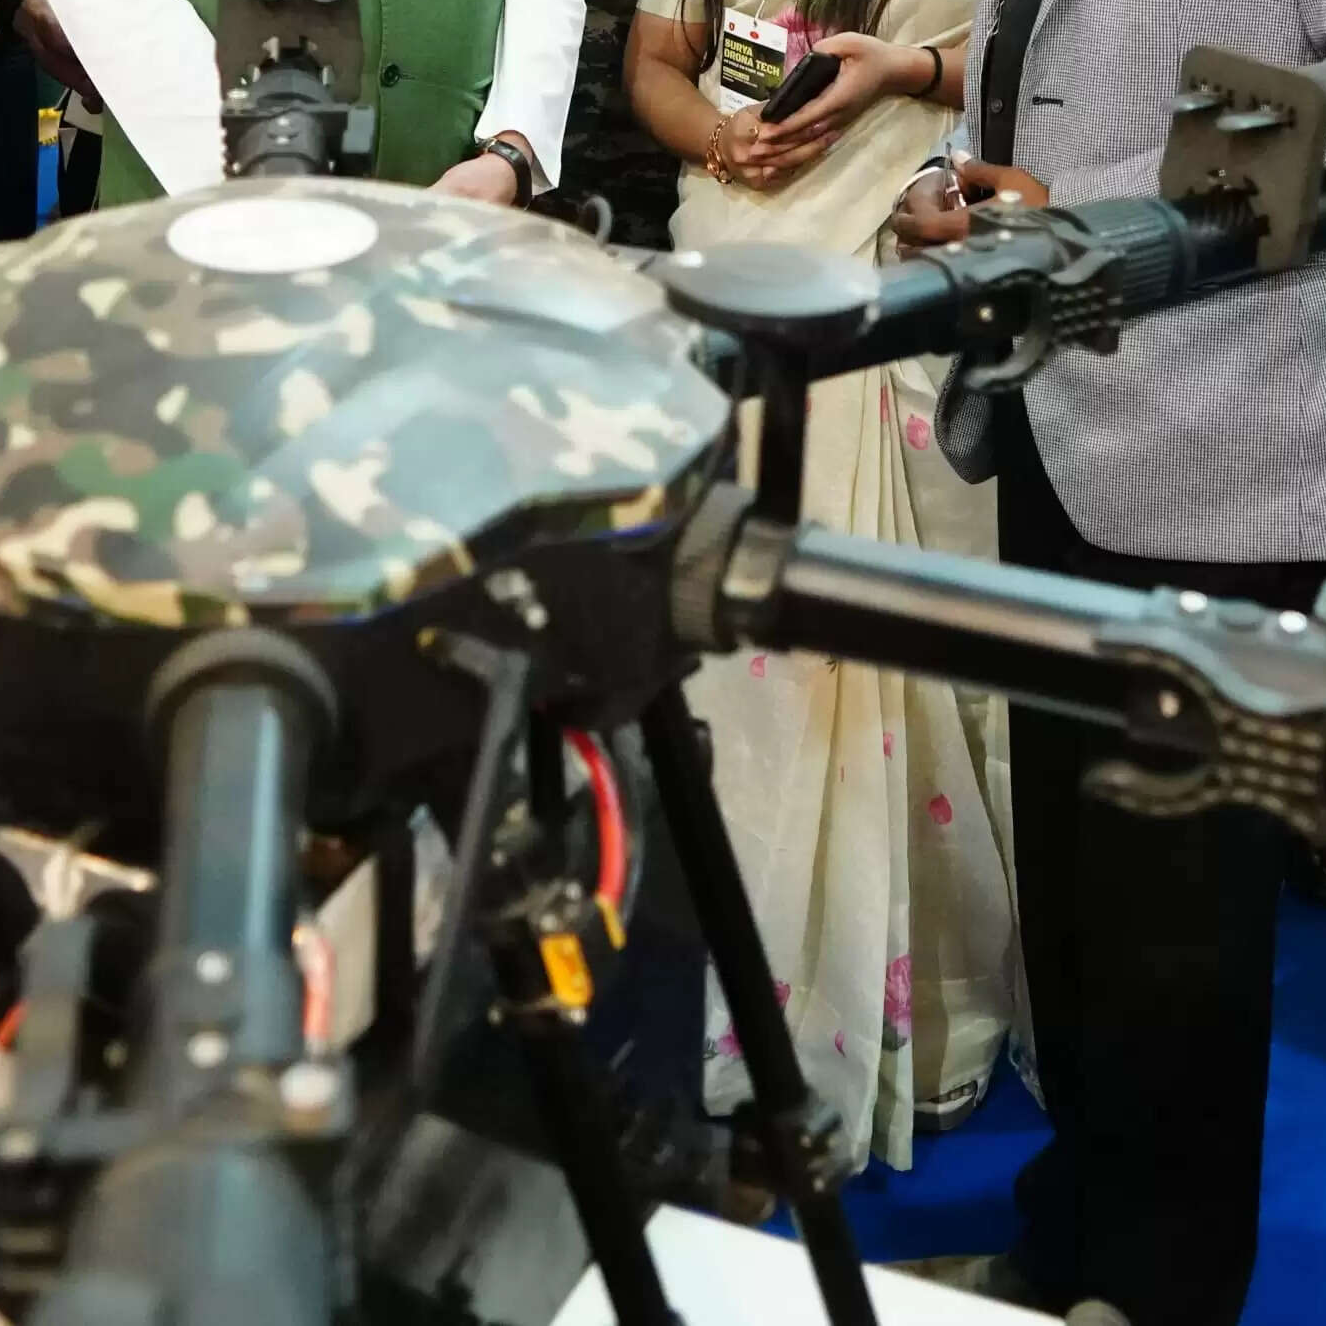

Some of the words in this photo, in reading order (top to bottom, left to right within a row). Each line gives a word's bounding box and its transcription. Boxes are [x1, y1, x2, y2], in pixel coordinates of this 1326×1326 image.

[724, 37, 753, 58] SURYA
[723, 47, 755, 68] DRONA
[755, 59, 781, 78] TECH
